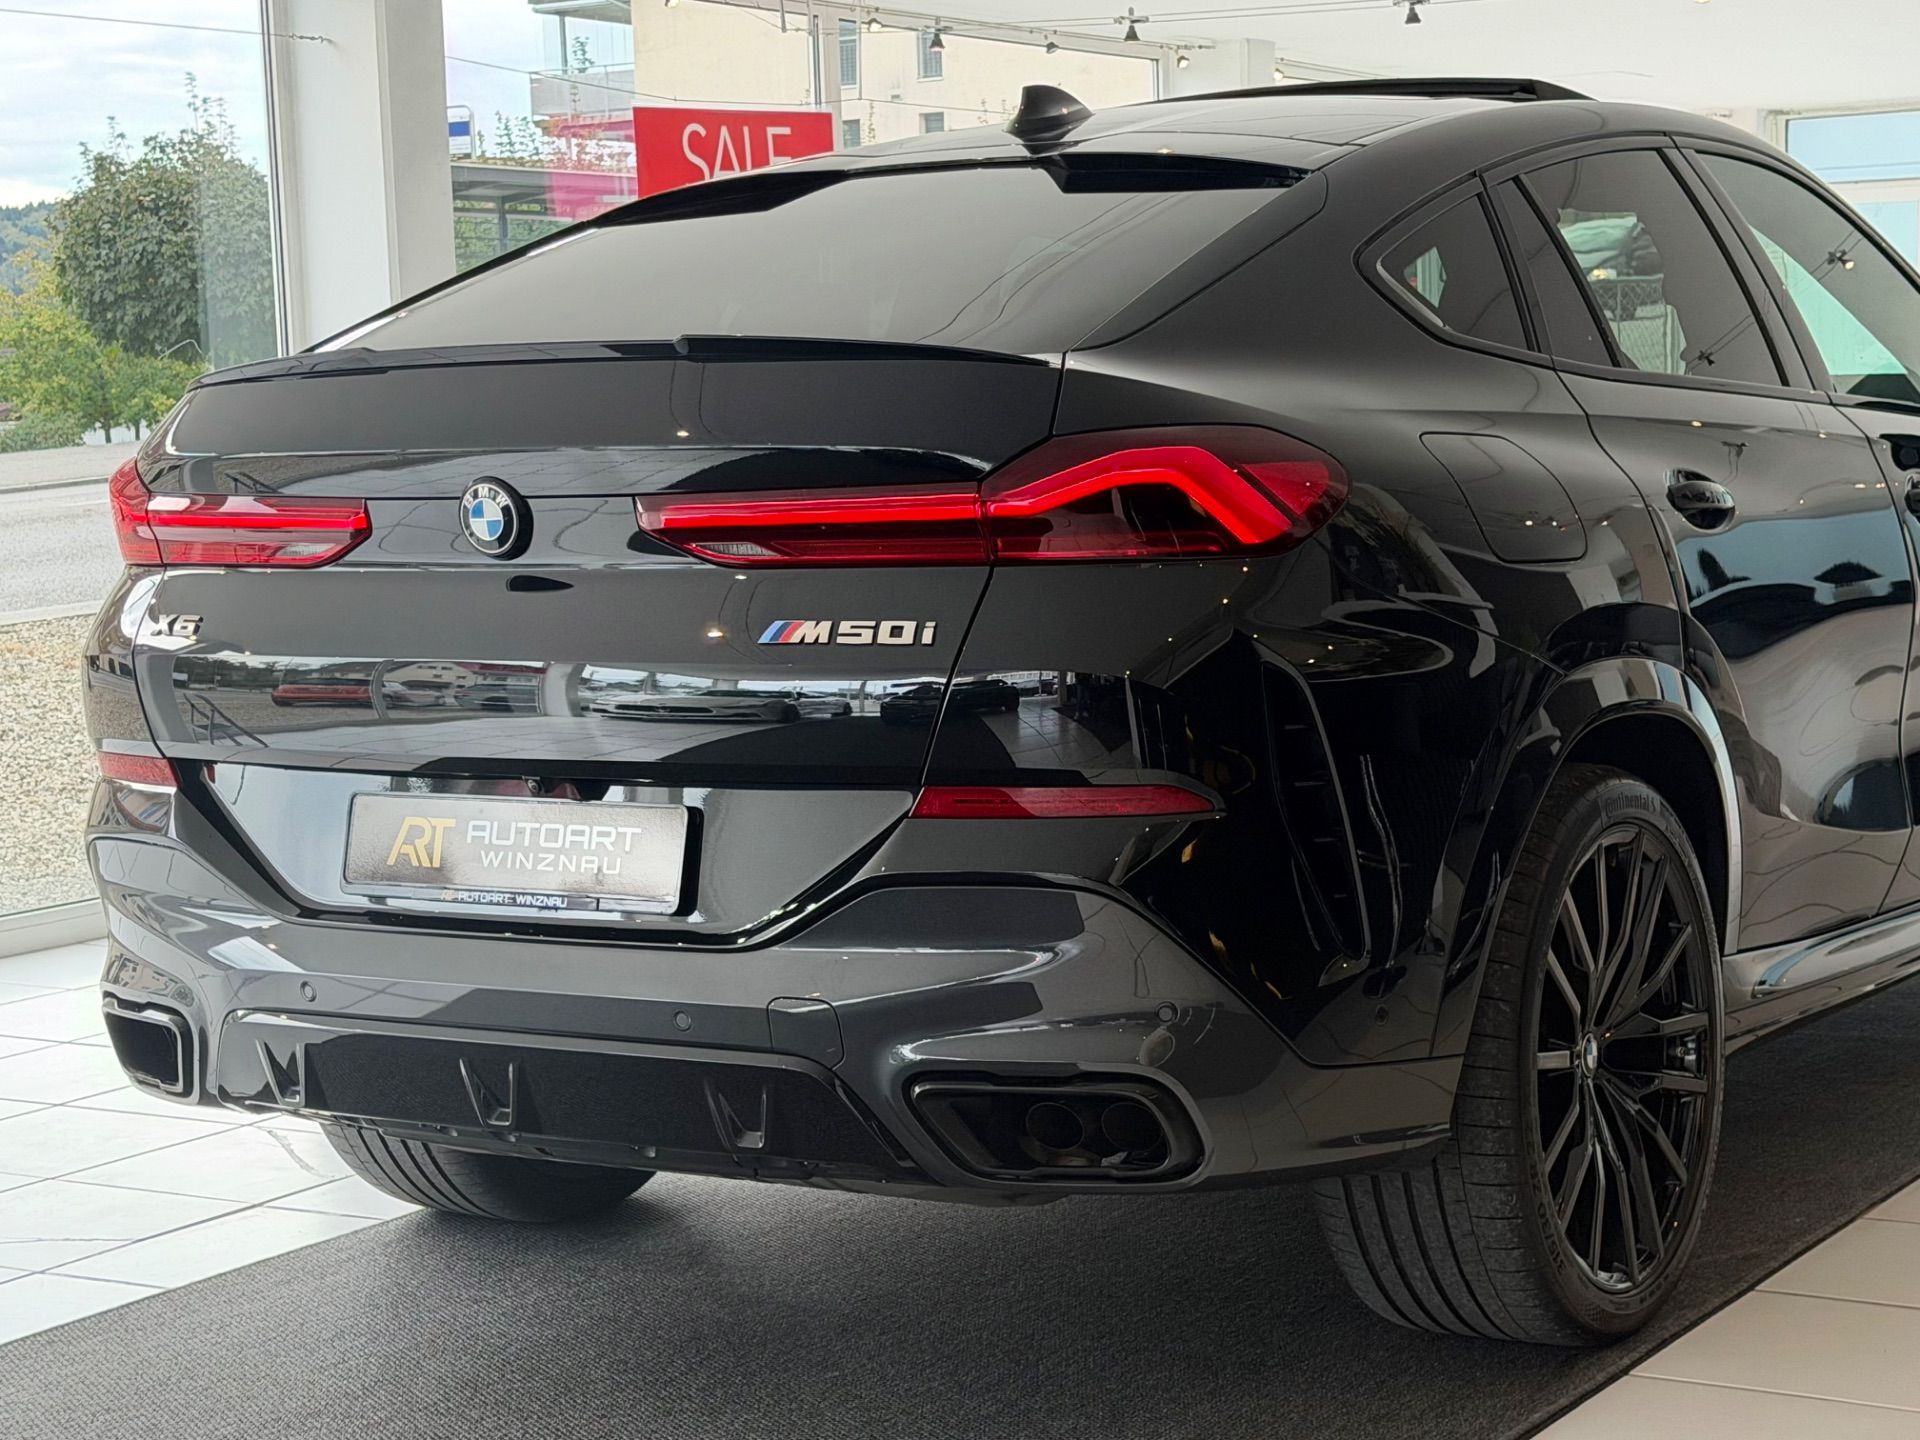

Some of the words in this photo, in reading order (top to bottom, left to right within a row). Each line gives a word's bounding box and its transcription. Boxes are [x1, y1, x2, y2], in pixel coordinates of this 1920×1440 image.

[682, 122, 792, 183] SALE
[464, 486, 509, 509] BMW
[150, 614, 202, 636] X6
[774, 620, 937, 645] M50i
[467, 819, 642, 852] AUTOART
[481, 849, 622, 875] WINZNAU
[515, 894, 568, 908] WINZNAU
